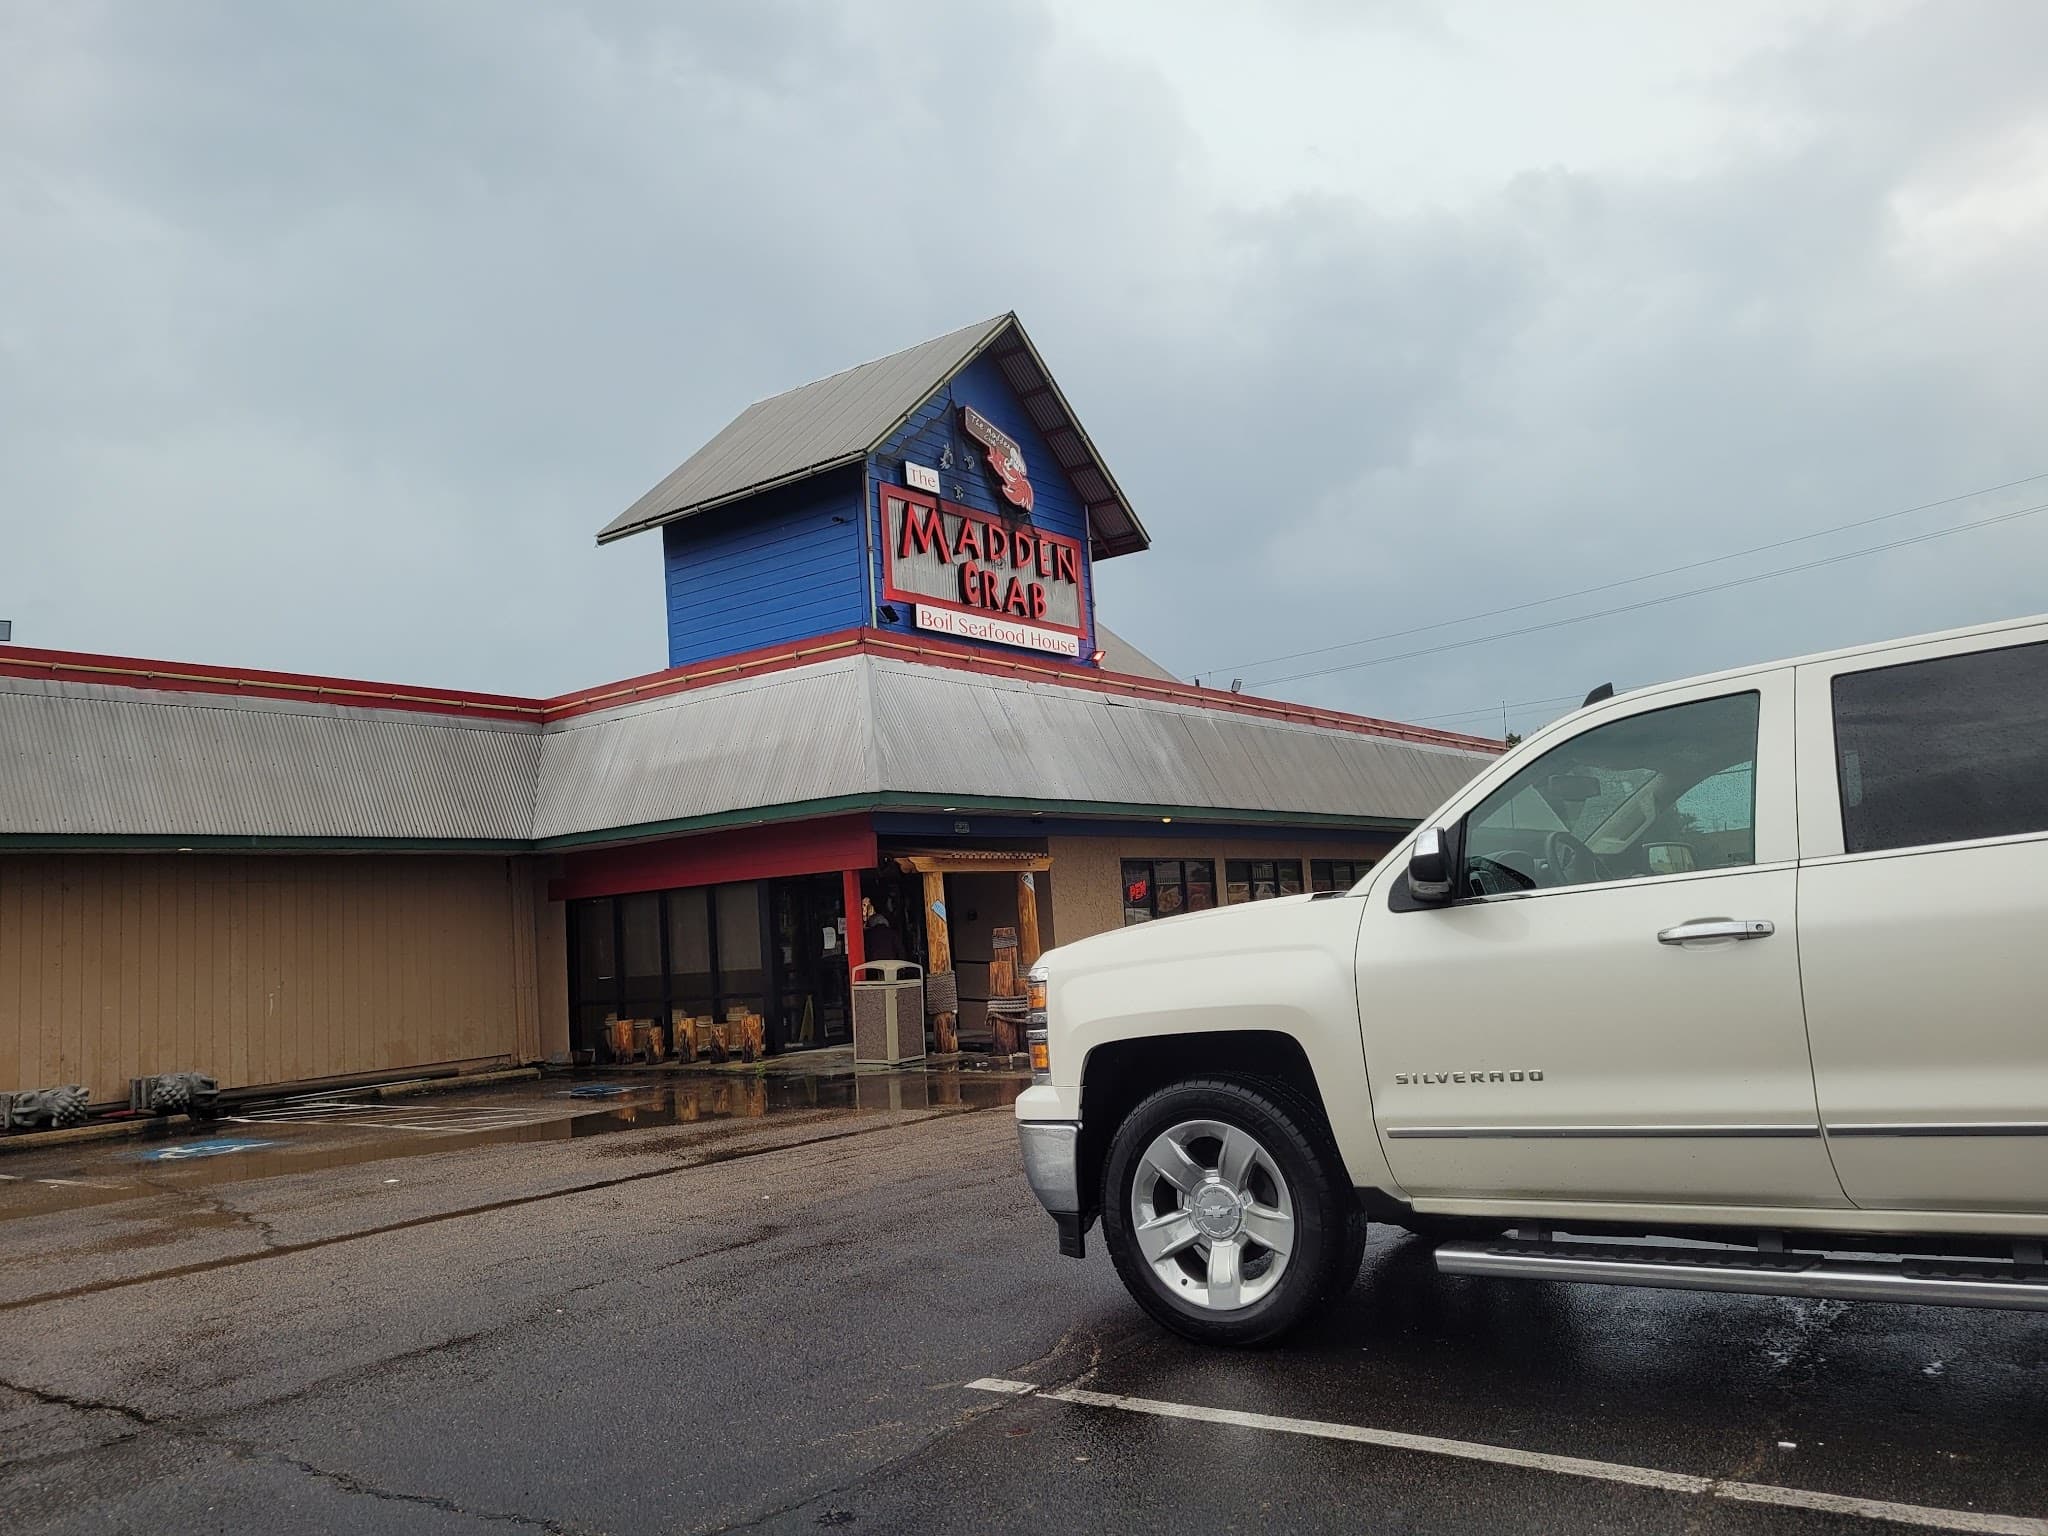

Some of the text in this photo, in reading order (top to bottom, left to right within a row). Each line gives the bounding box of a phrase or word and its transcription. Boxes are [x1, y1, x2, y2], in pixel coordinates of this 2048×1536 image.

[911, 468, 936, 488] The
[899, 501, 1077, 584] MADDEN
[959, 560, 1047, 618] CRAB
[921, 610, 1076, 654] Boil Seafood House
[1395, 1069, 1544, 1085] SILVERADO
